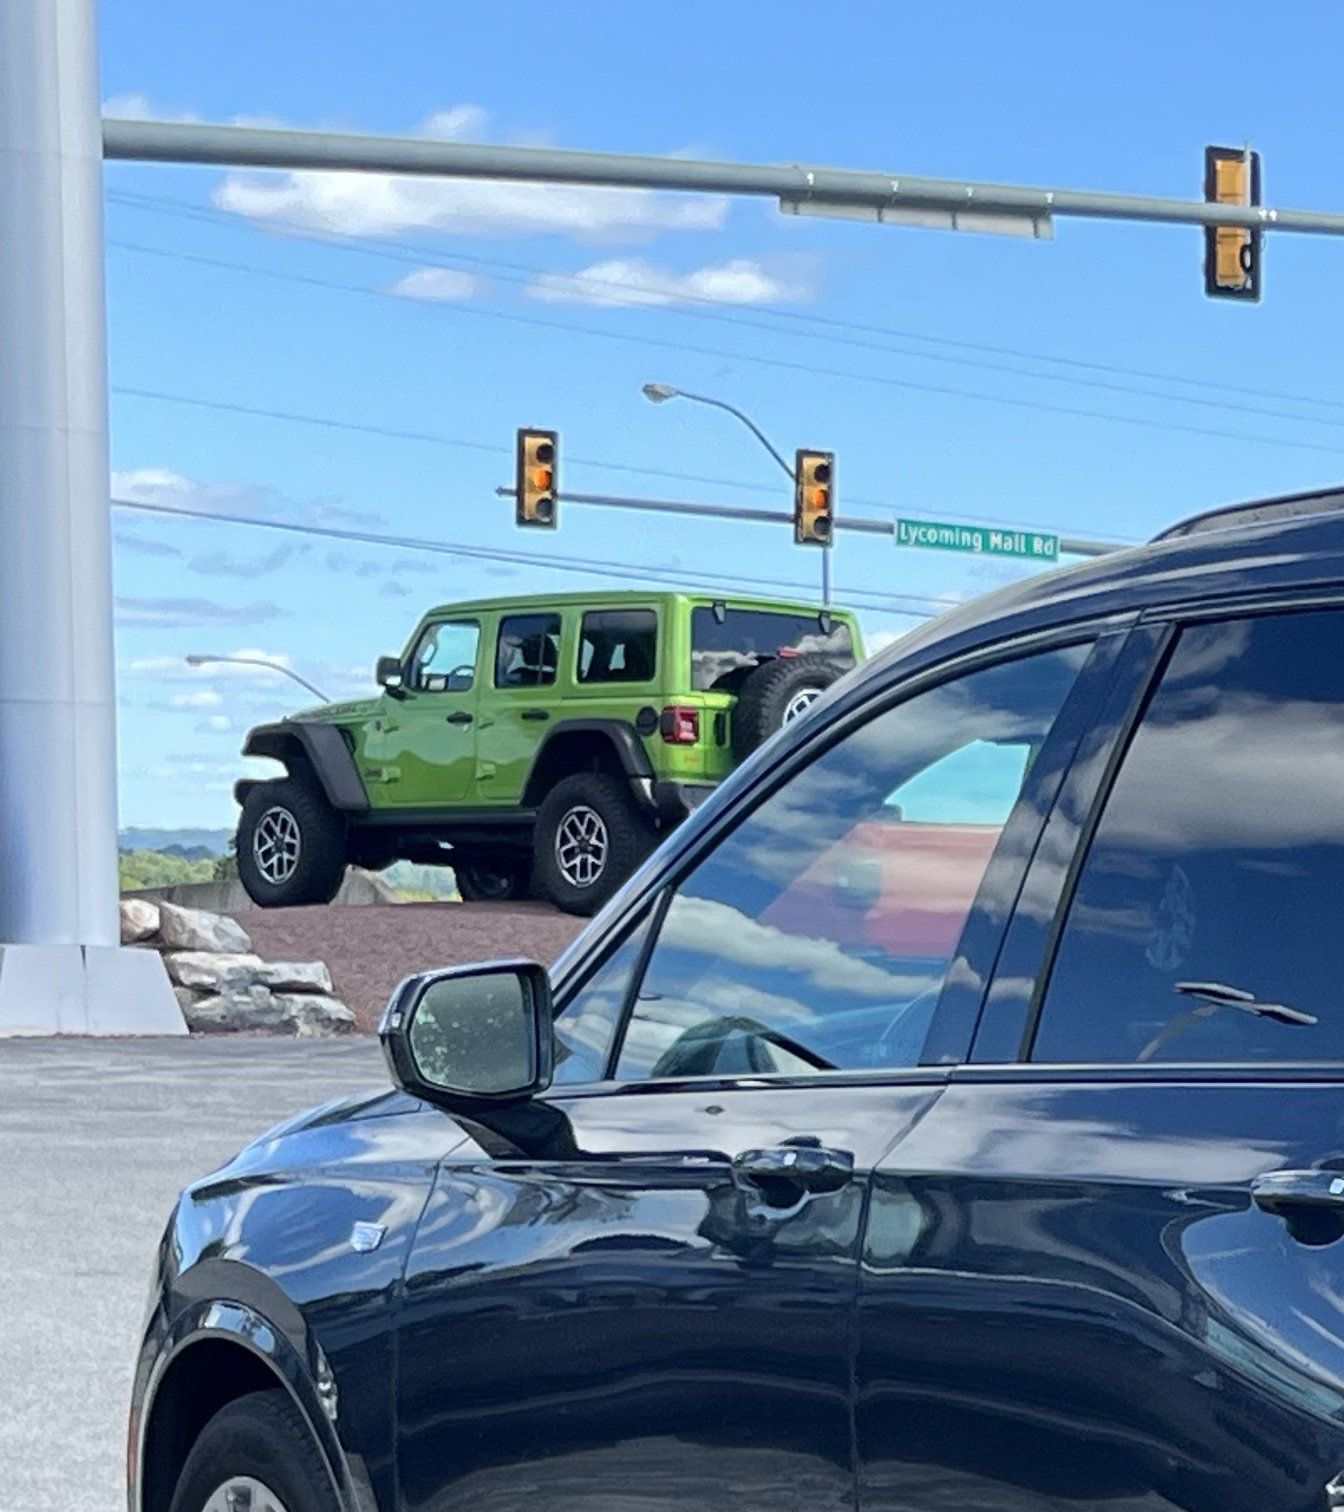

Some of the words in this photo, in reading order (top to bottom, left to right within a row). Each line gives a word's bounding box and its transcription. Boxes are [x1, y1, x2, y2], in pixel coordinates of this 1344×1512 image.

[900, 522, 982, 553] Lycoming
[989, 531, 1026, 554] Mall
[1032, 535, 1054, 556] Rd
